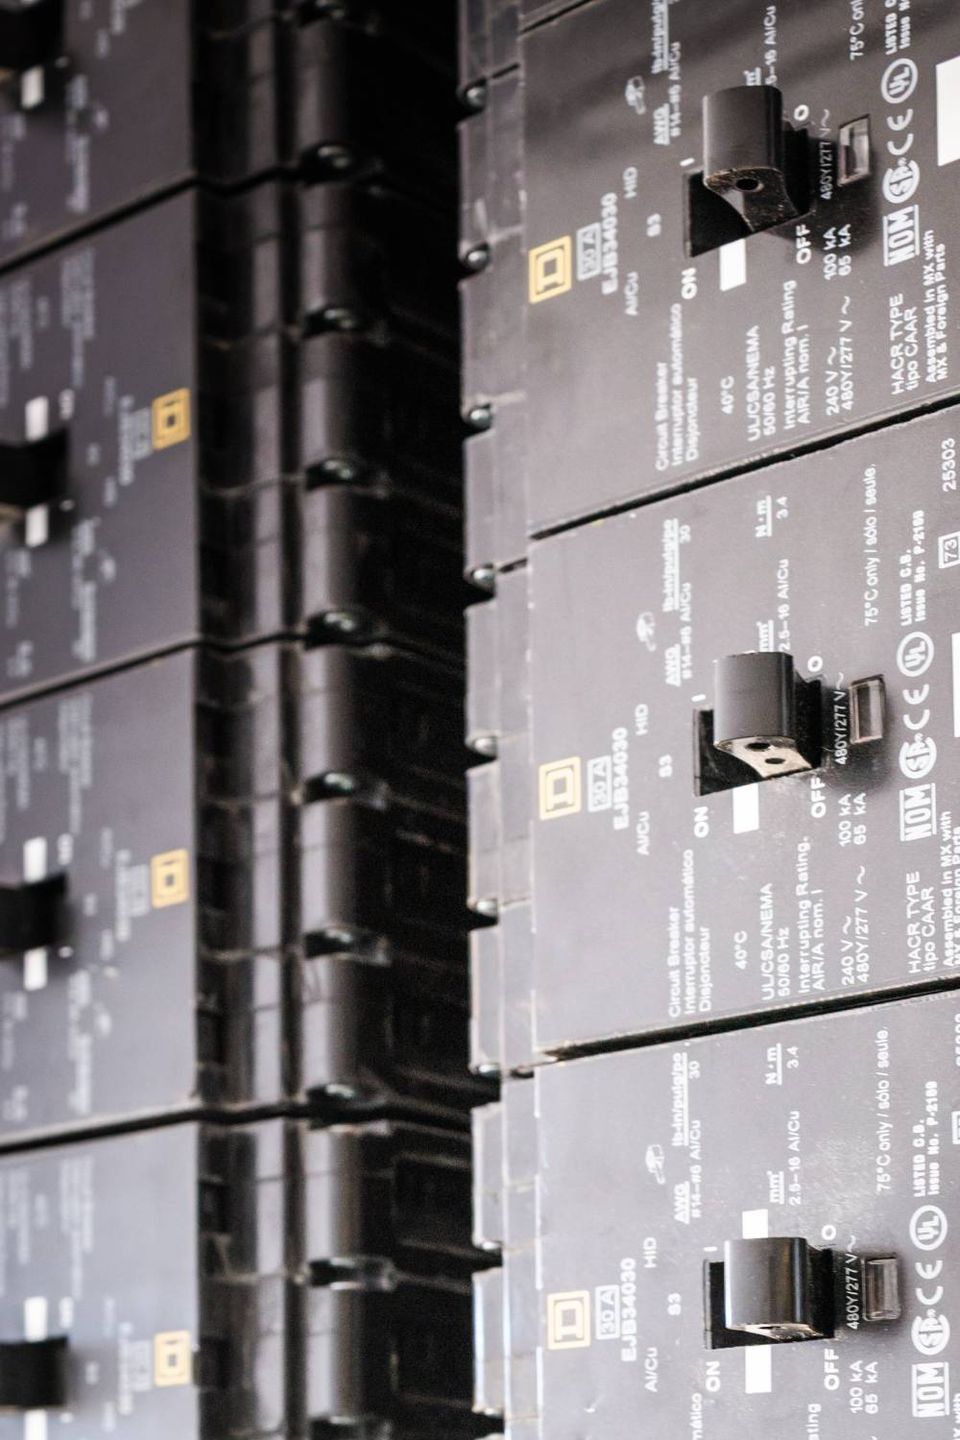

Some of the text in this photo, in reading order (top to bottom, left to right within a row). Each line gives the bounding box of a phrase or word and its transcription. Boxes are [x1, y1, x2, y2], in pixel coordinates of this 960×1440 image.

[850, 23, 864, 60] 75°C
[885, 13, 897, 55] LISTED
[624, 167, 638, 199] HID
[820, 141, 832, 200] 480Y/277
[601, 192, 619, 295] EJB34030
[796, 224, 811, 264] OFF
[823, 227, 837, 280] 100 kA
[838, 224, 851, 276] 65 kA
[682, 267, 697, 299] ON
[923, 230, 938, 382] Assembled MX with
[935, 243, 950, 380] MX Foreign Parts
[782, 280, 797, 428] Interrupting Rating
[890, 293, 904, 395] HACR TYPE
[905, 307, 920, 390] tipo CAAR
[670, 303, 684, 465] Interruptor automático
[747, 326, 761, 441] UL/CSA/NEMA
[763, 366, 776, 435] 50/60 Hz
[798, 333, 810, 424] AIR/A nom.
[826, 386, 839, 415] 240
[840, 337, 854, 410] 480Y/277
[656, 362, 669, 471] Circuit Breaker
[686, 377, 700, 461] Disjoncteur
[942, 438, 957, 492] 25303
[777, 496, 789, 519] 3.4
[776, 559, 790, 599] Al/Cu
[862, 516, 880, 627] 75°C only sólo
[900, 583, 913, 626] LISTED
[912, 584, 926, 622] Issue
[635, 704, 649, 736] HID
[834, 701, 848, 765] 480Y/277
[613, 727, 629, 830] EJB34030
[811, 777, 826, 818] OFF
[694, 806, 709, 838] ON
[839, 793, 853, 847] 100 kA
[854, 792, 867, 845] 65 kA
[940, 811, 955, 967] Assembled MX with
[681, 849, 697, 1015] Interruptor automático
[734, 931, 748, 969] 40°C
[760, 883, 774, 1000] UL/CSA/NEMA
[798, 900, 813, 993] Interrupting
[813, 898, 825, 990] AIR/A nom.
[856, 907, 869, 982] 480Y/277
[907, 871, 922, 974] HACR TYPE
[922, 886, 938, 971] tipo CAAR
[667, 906, 681, 1017] Circuit Breaker
[699, 926, 713, 1012] Disjoncteur
[777, 927, 790, 997] 50/60 Hz
[842, 957, 855, 985] 240
[688, 1060, 700, 1079] 30
[787, 1046, 799, 1068] 3.4
[689, 1120, 701, 1160] Al/Cu
[788, 1111, 801, 1152] Al/Cu
[876, 1080, 892, 1192] 75°C only sólo
[913, 1154, 926, 1197] LISTED
[927, 1133, 940, 1195] Issue No.
[643, 1237, 658, 1268] HID
[621, 1257, 637, 1362] EJB34030
[668, 1293, 682, 1316] S3
[845, 1268, 860, 1329] 480Y/277
[644, 1347, 659, 1392] Al/Cu
[706, 1361, 721, 1392] ON
[824, 1348, 840, 1390] OFF
[850, 1361, 863, 1414] 100 kA
[865, 1361, 878, 1414] 65 kA
